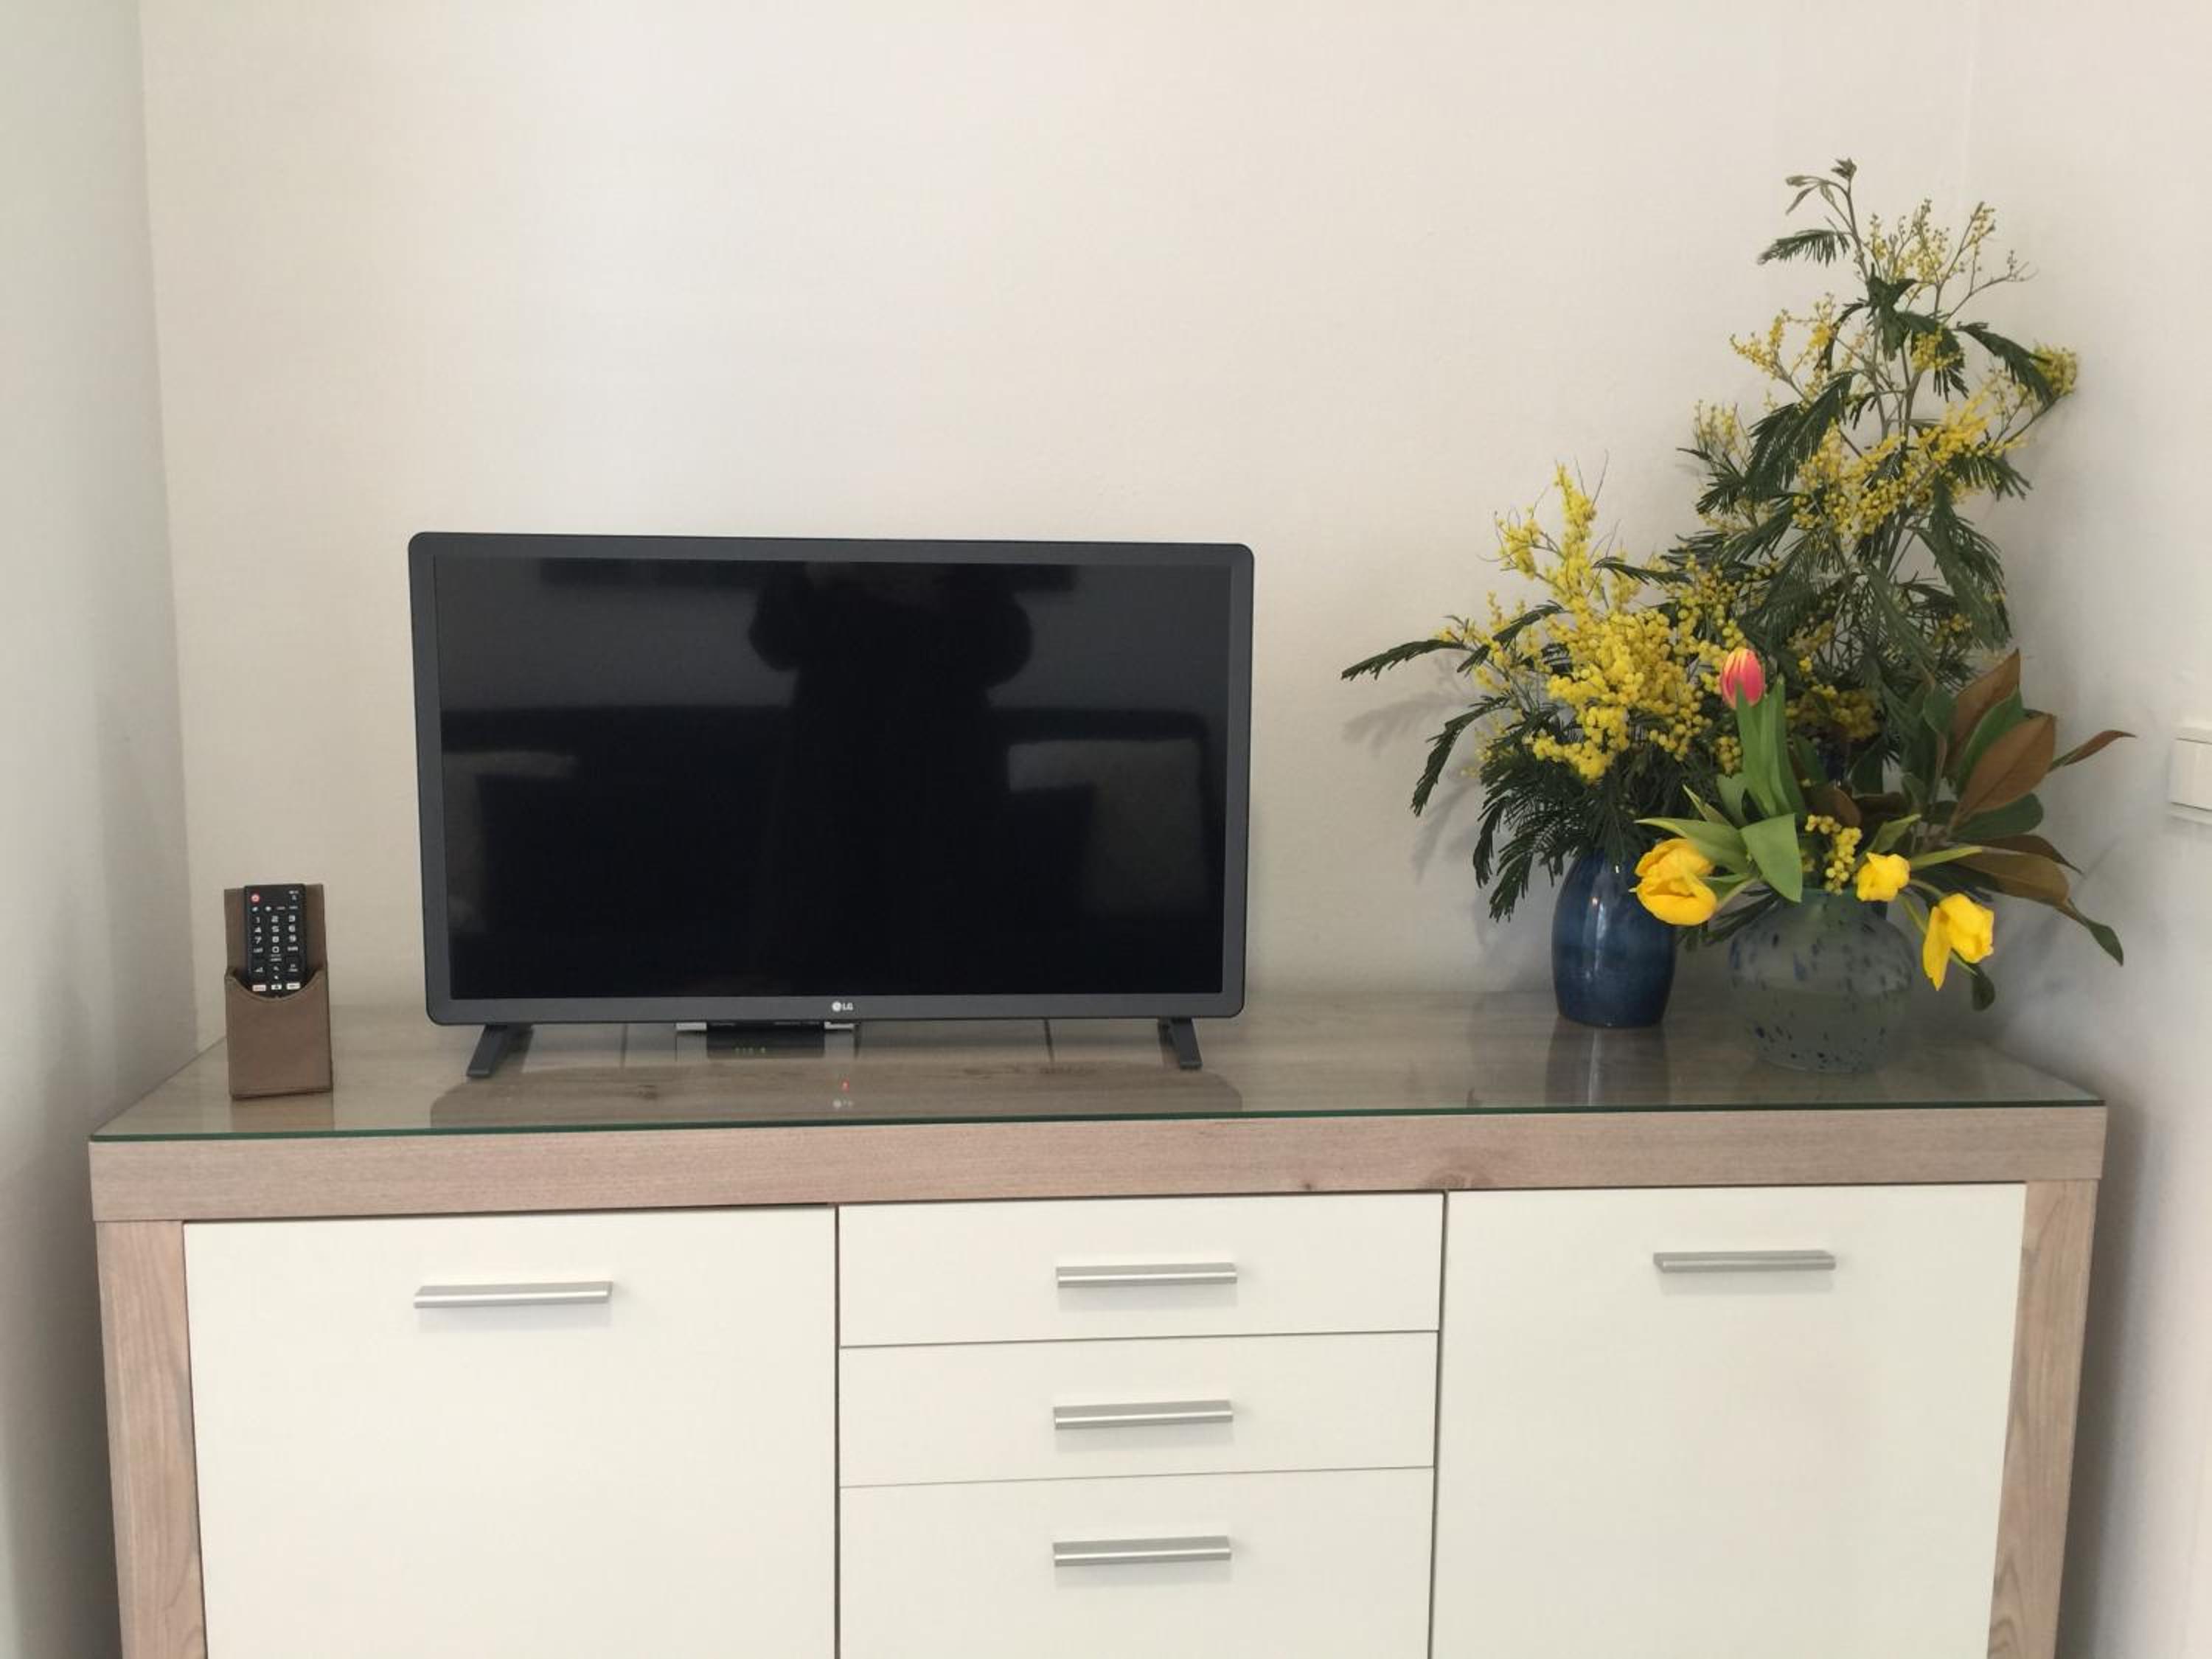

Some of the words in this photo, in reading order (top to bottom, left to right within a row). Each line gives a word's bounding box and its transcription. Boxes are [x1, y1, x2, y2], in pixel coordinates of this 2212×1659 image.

[271, 915, 279, 923] 2
[254, 936, 262, 944] 7
[843, 1002, 853, 1011] LG
